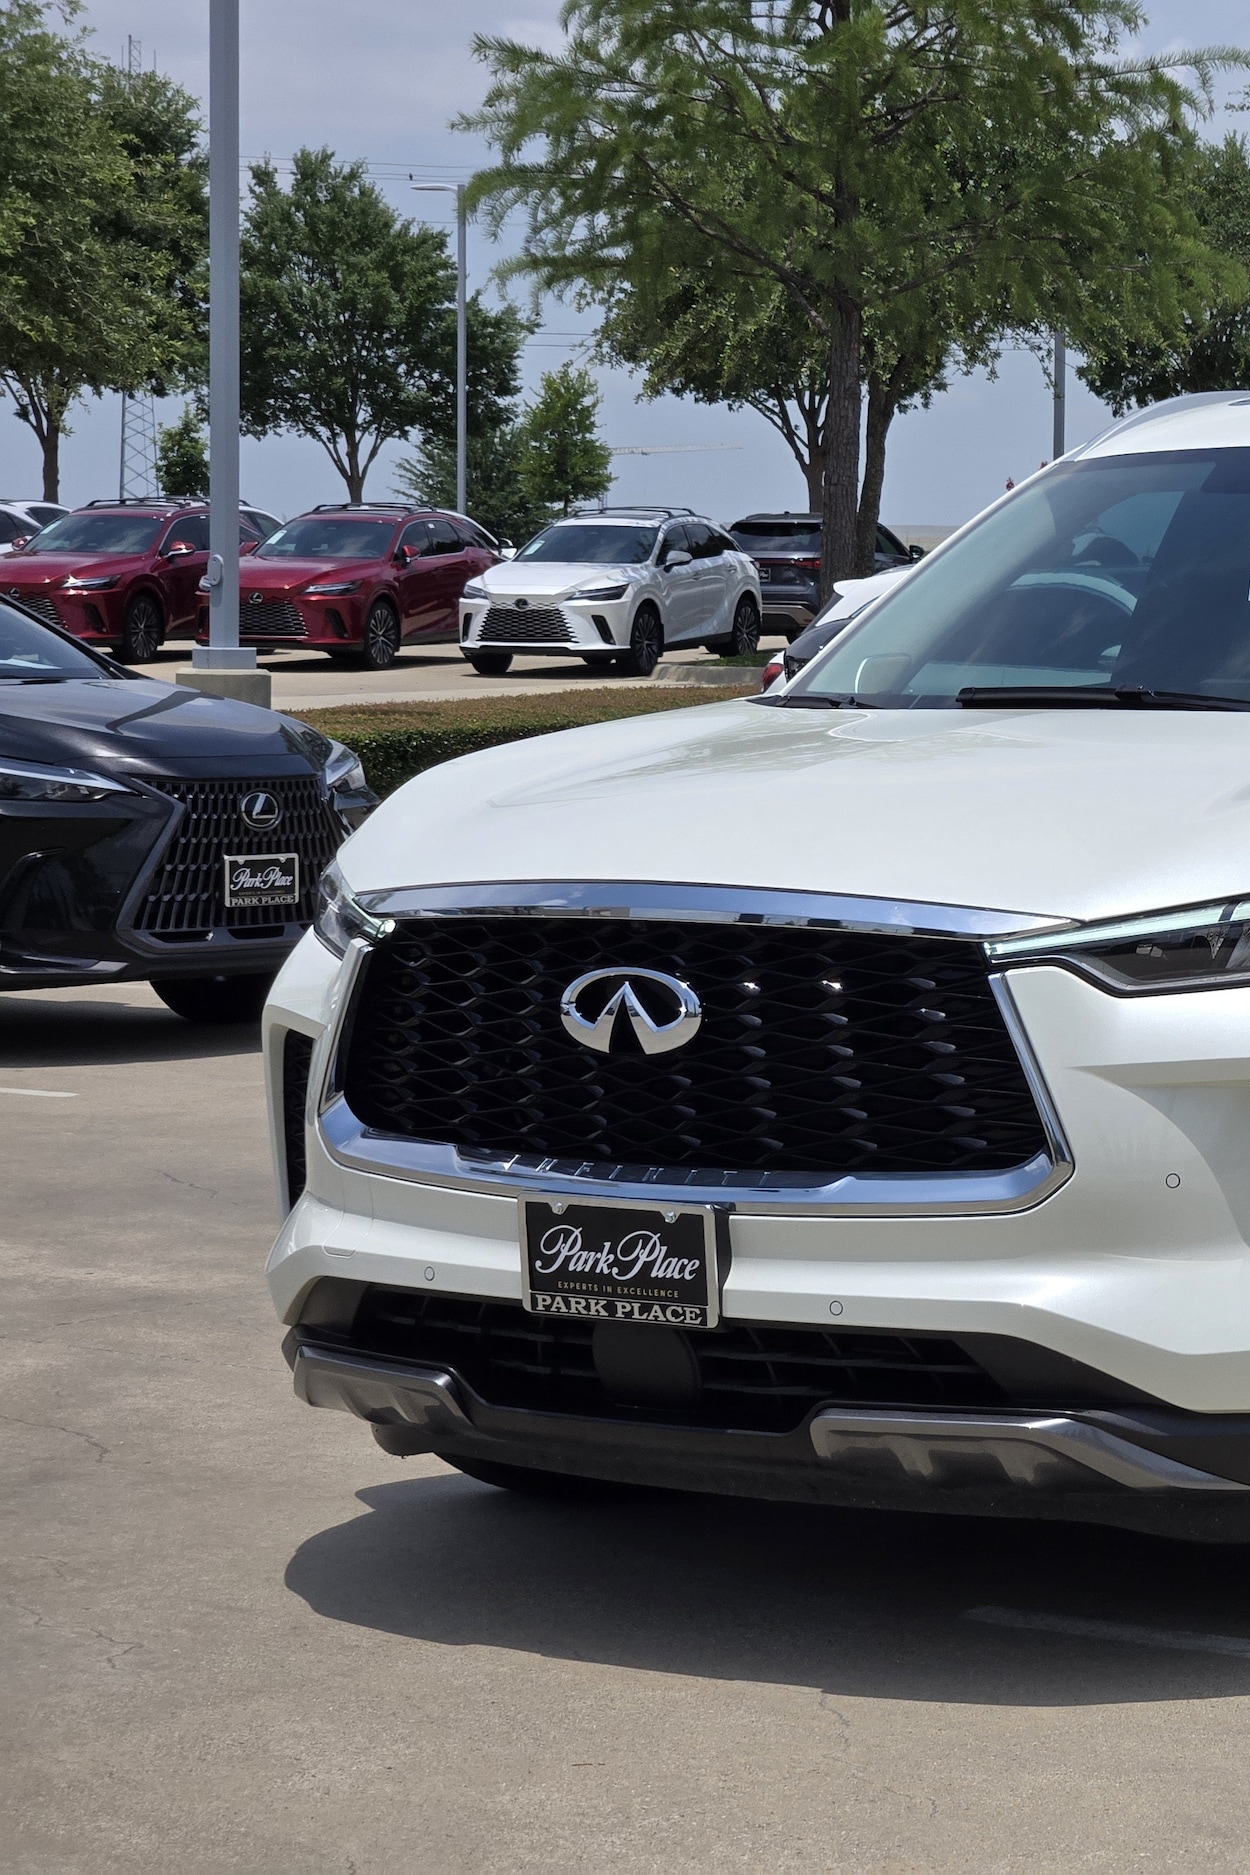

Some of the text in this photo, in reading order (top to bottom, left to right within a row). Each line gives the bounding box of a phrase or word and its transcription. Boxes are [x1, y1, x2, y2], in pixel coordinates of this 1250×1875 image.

[230, 866, 293, 891] Park Place
[231, 895, 294, 906] PARK PLACE
[535, 1224, 700, 1281] Park Place
[557, 1280, 680, 1298] EXPERTS IN EXCELLENCE
[535, 1294, 703, 1325] PARK PLACE
